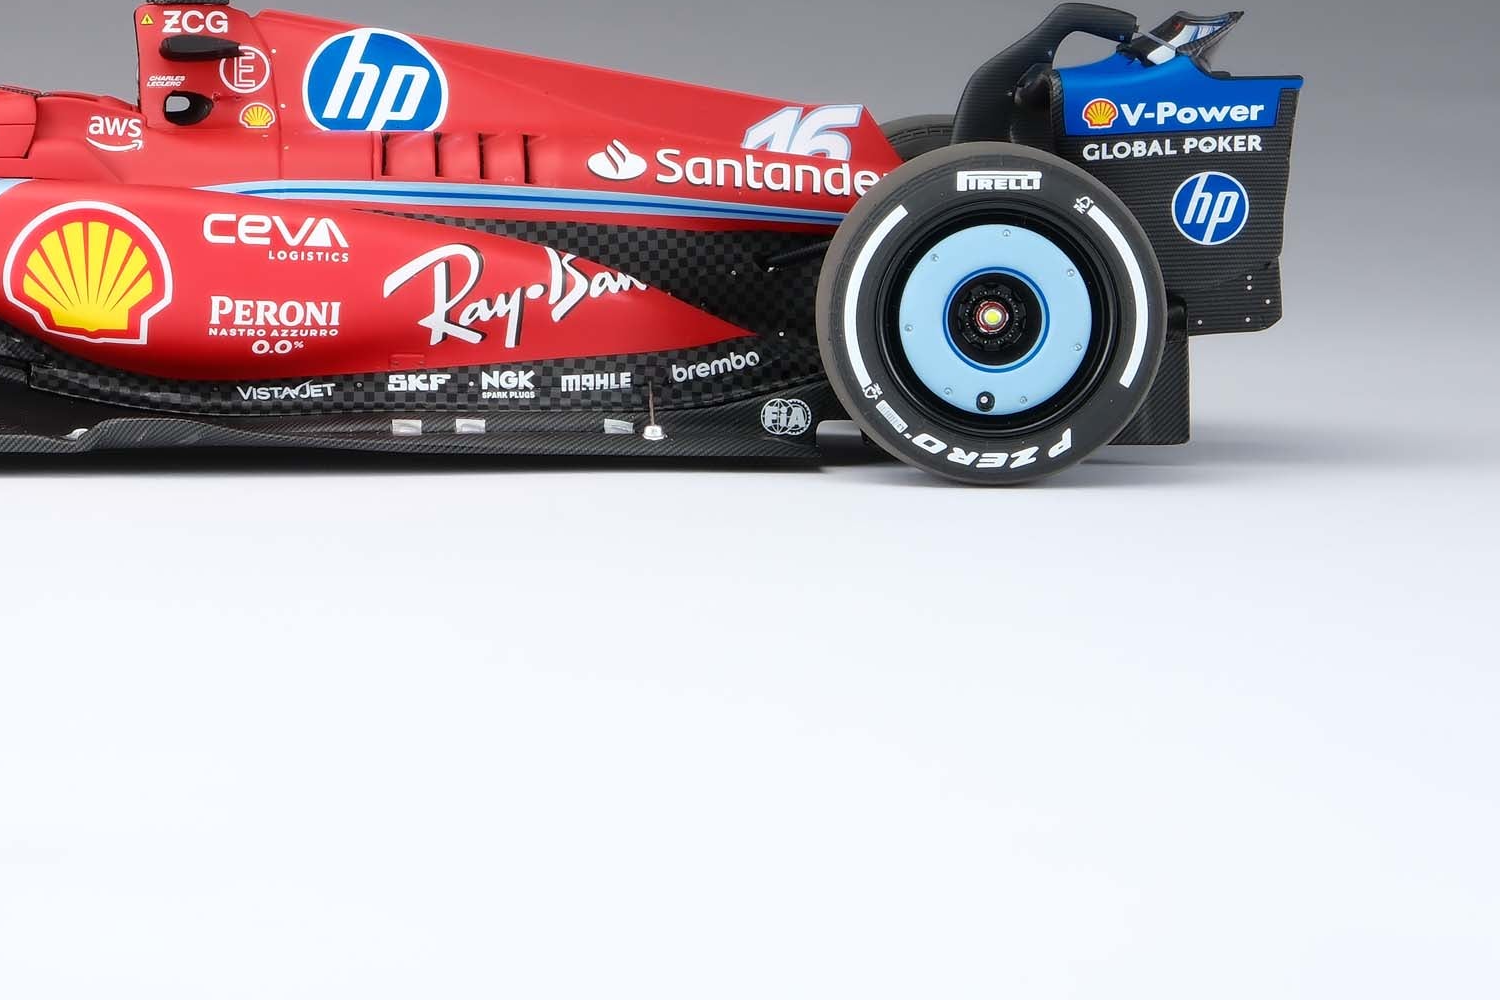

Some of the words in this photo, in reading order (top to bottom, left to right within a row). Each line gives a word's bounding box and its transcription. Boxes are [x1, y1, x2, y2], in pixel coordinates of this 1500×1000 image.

[162, 10, 228, 33] ZCG
[322, 30, 430, 131] hp
[1120, 102, 1265, 126] V-Power
[89, 116, 142, 137] aws
[740, 104, 864, 161] 16
[1082, 139, 1177, 161] GLOBAL
[1183, 134, 1262, 154] POKER
[957, 170, 1042, 191] PIRELLI
[1183, 173, 1239, 243] hp
[268, 250, 349, 263] LOGISTICS
[209, 295, 341, 326] PERONI
[208, 328, 266, 337] NASTRO
[270, 328, 339, 338] AZZURRO
[671, 351, 760, 383] brembo
[387, 374, 451, 391] SKF
[481, 370, 535, 390] NGK
[561, 372, 632, 392] MAHLE
[481, 390, 508, 399] SPARK
[509, 390, 536, 399] PLUGS
[911, 433, 1040, 468] ZERO
[1048, 427, 1072, 458] P
